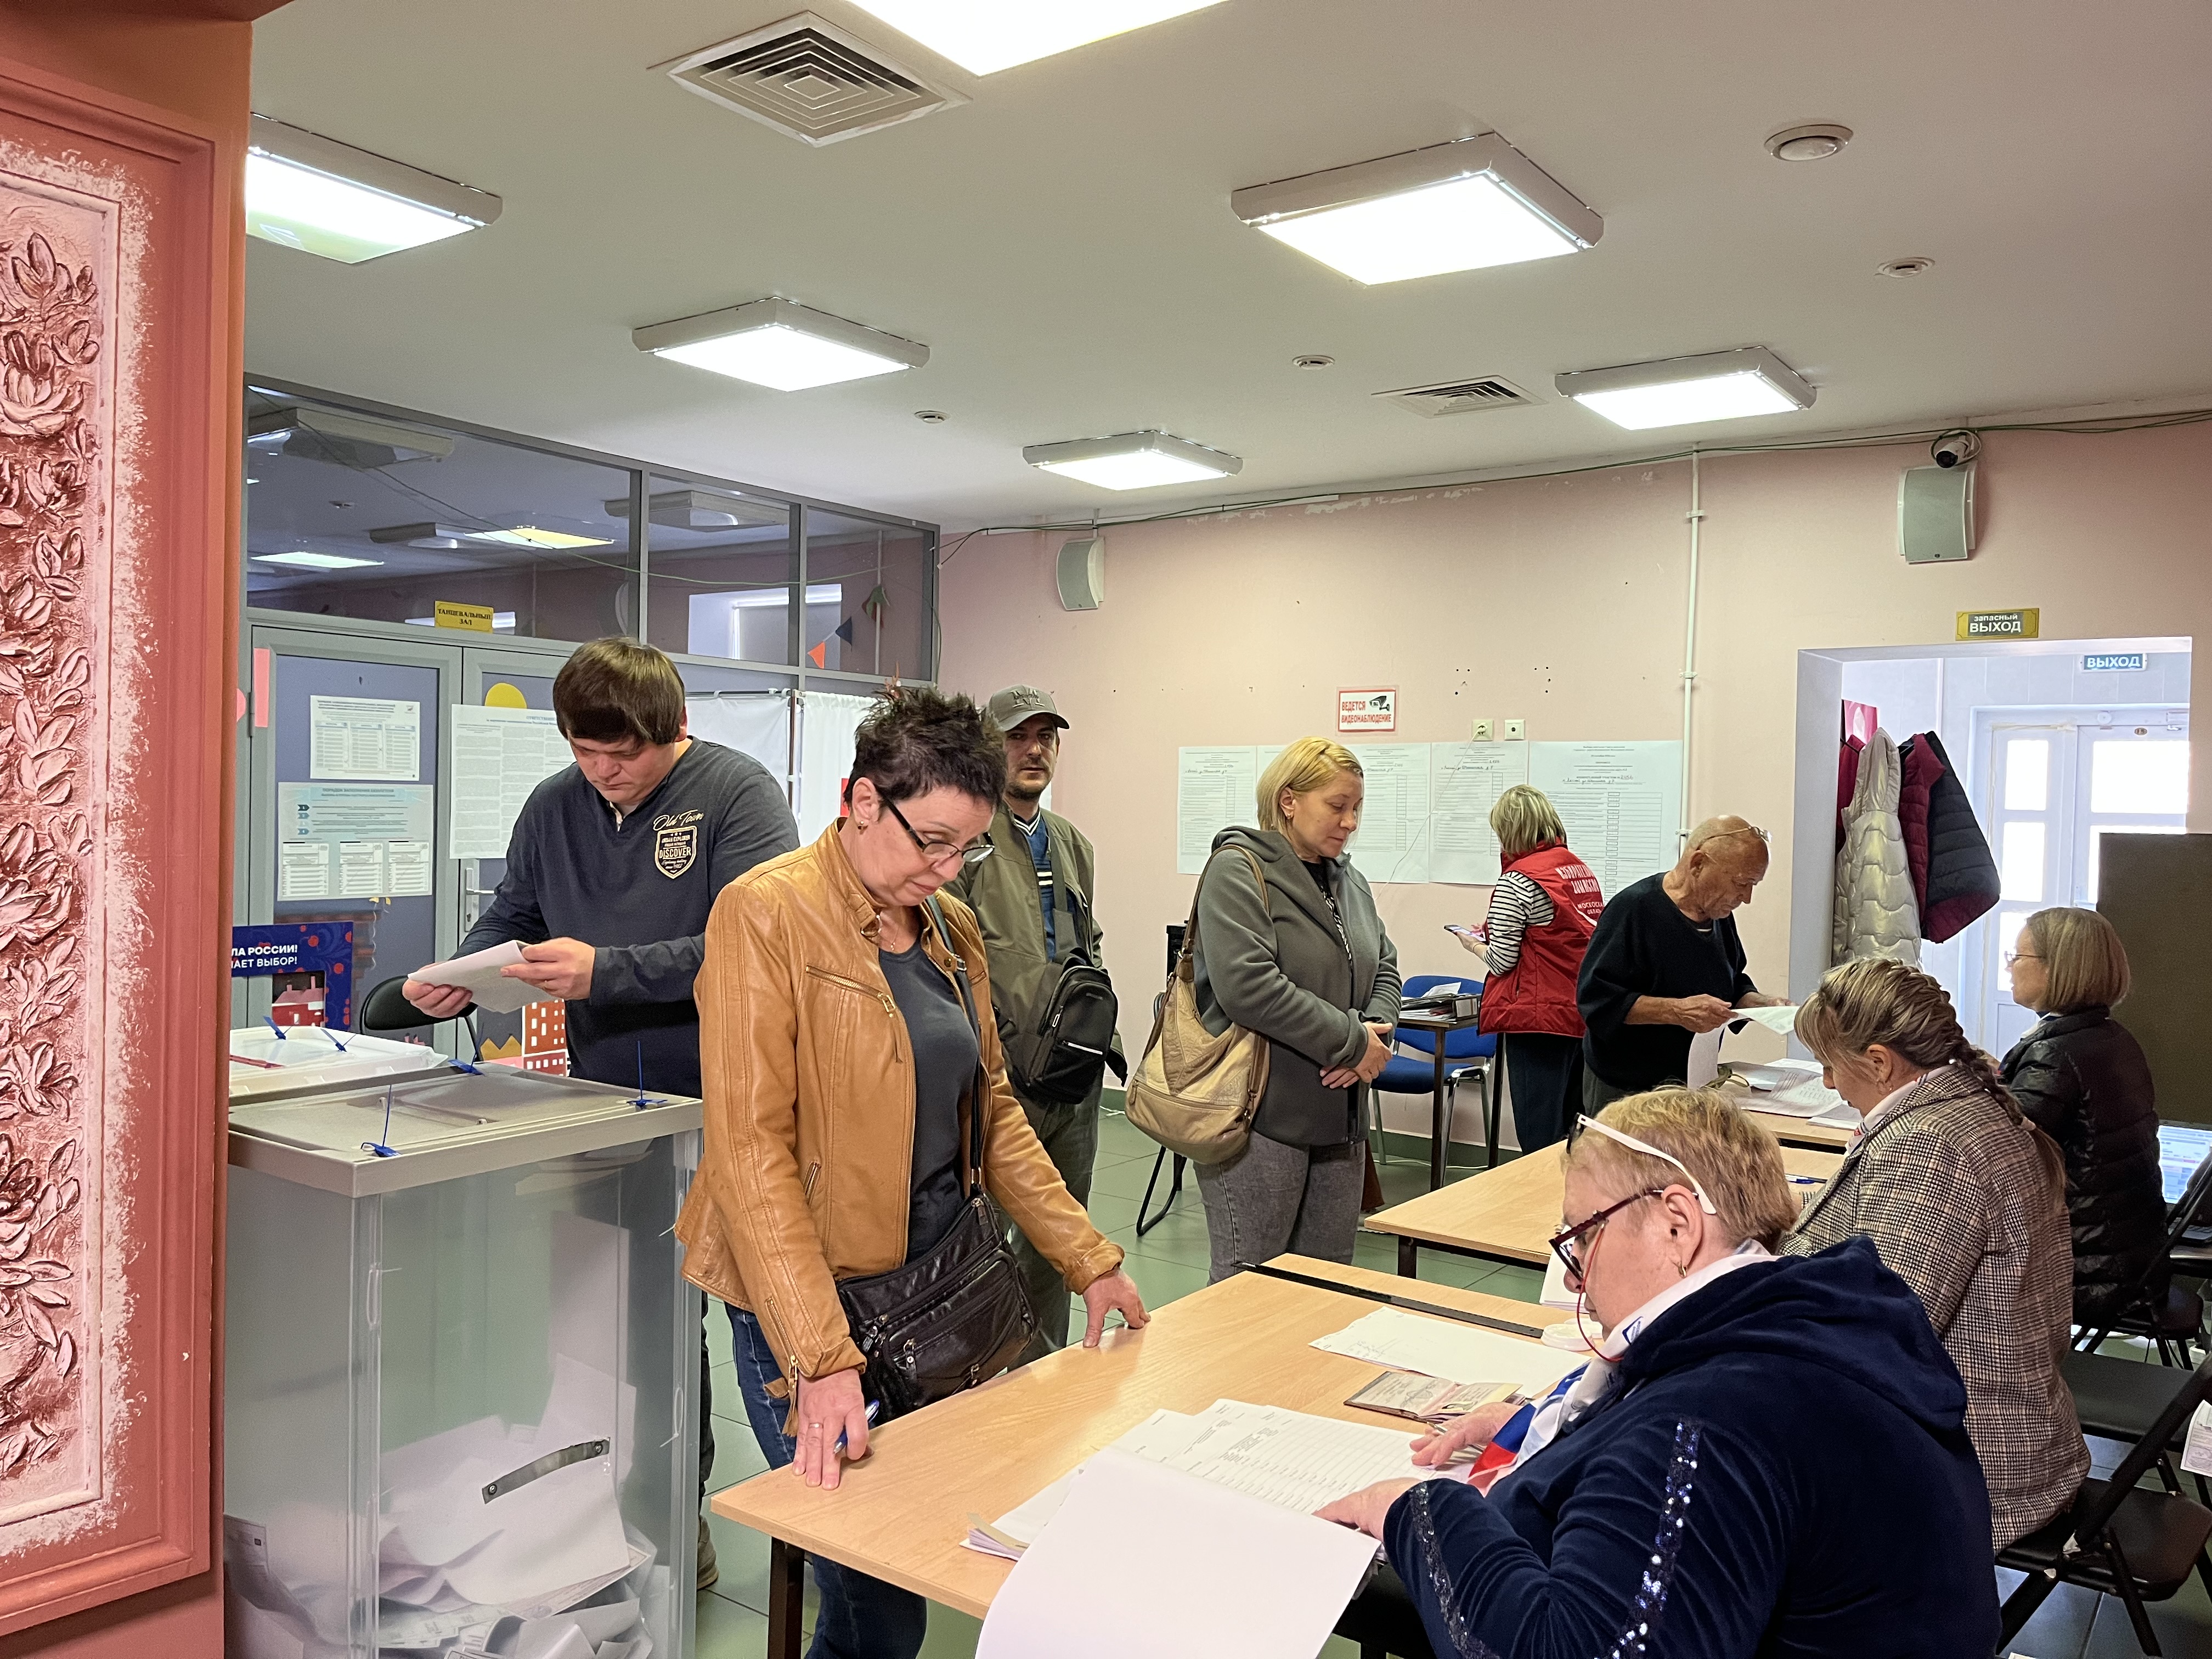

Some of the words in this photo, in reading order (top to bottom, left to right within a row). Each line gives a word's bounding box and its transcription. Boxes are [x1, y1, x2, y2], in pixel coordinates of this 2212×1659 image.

[1973, 613, 2018, 622] запасный
[1970, 621, 2021, 633] ВЫХОД
[2087, 656, 2141, 668] ВЫХОД
[1341, 701, 1365, 713] ВЕДЕТСЯ
[1341, 714, 1392, 725] ВИДЕОНАБЛЮДЕНИЕ
[653, 814, 680, 831] Old
[659, 847, 691, 859] DISCOVER
[248, 944, 297, 955] РОССИИ!
[256, 956, 297, 967] ВЫБОР!
